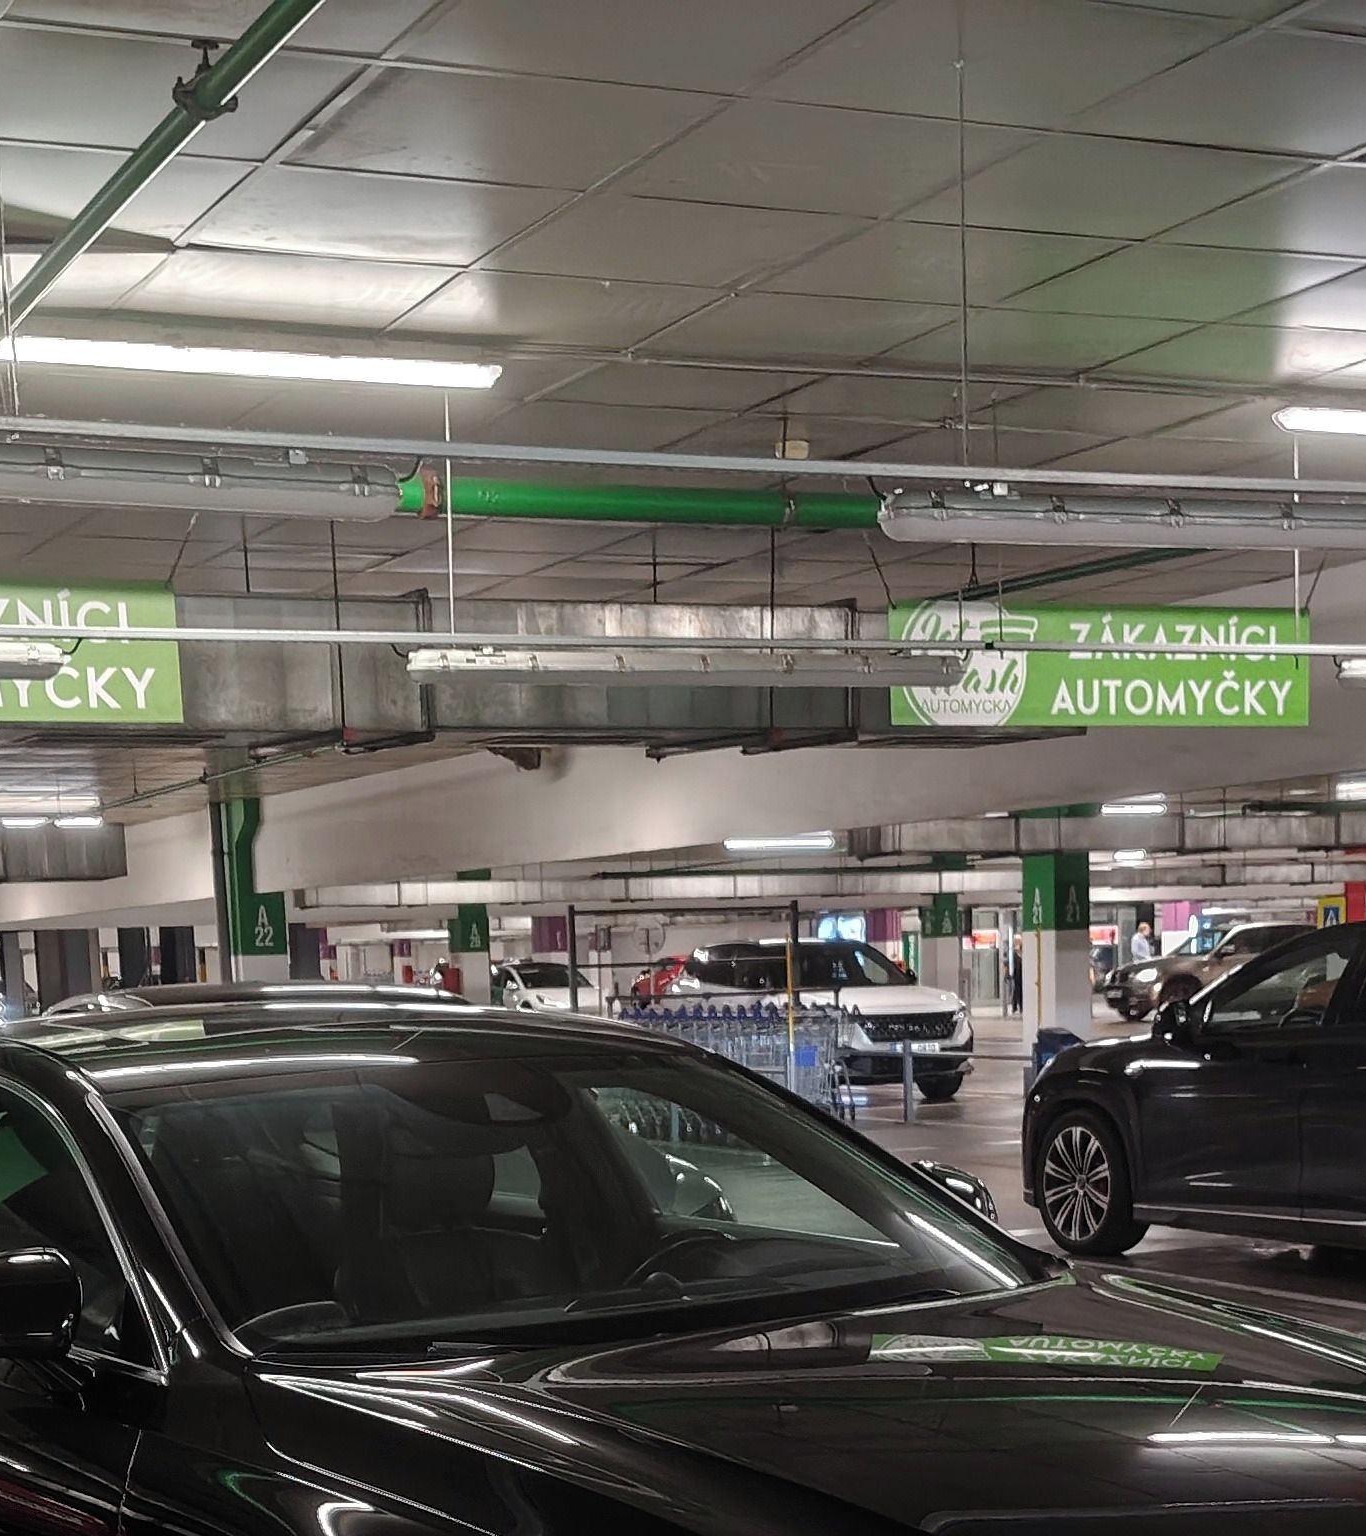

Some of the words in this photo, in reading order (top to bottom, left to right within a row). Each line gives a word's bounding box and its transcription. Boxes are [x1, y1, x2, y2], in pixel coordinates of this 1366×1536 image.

[1068, 612, 1277, 662] ZÁKAZNÍCI
[1050, 671, 1293, 716] AUTOMYČKY
[1034, 887, 1041, 905] A
[258, 904, 269, 926] A
[255, 926, 274, 947] 22
